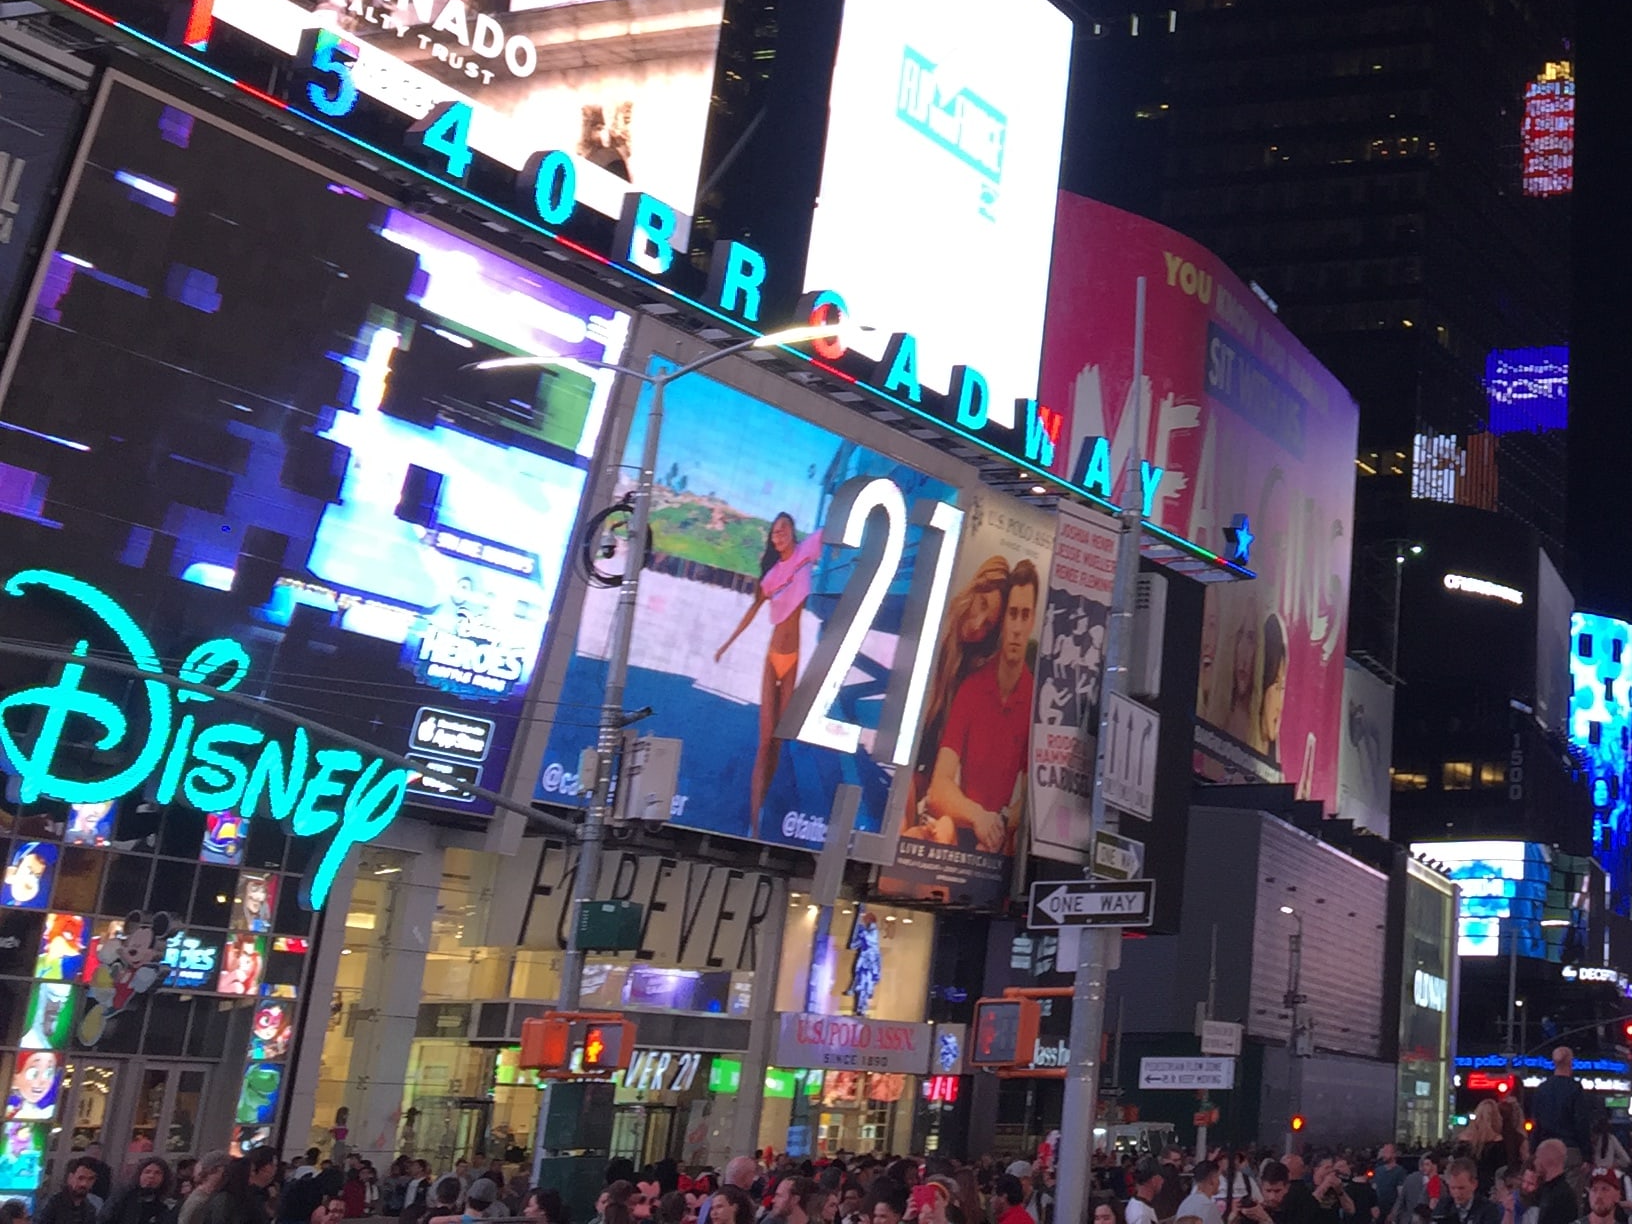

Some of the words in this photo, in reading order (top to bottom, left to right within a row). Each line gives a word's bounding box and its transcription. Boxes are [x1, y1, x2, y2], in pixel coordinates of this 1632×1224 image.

[417, 33, 496, 86] TRUST
[1162, 250, 1214, 306] YOU
[1207, 336, 1236, 395] SIT
[797, 477, 966, 766] 21
[417, 624, 524, 682] HEROES
[1509, 733, 1524, 801] 1500
[899, 841, 926, 857] LIVE
[1050, 894, 1084, 914] ONE
[1100, 893, 1138, 913] WAY
[823, 1052, 858, 1066] SINCE
[828, 1021, 873, 1049] POLO
[669, 1052, 702, 1091] 21
